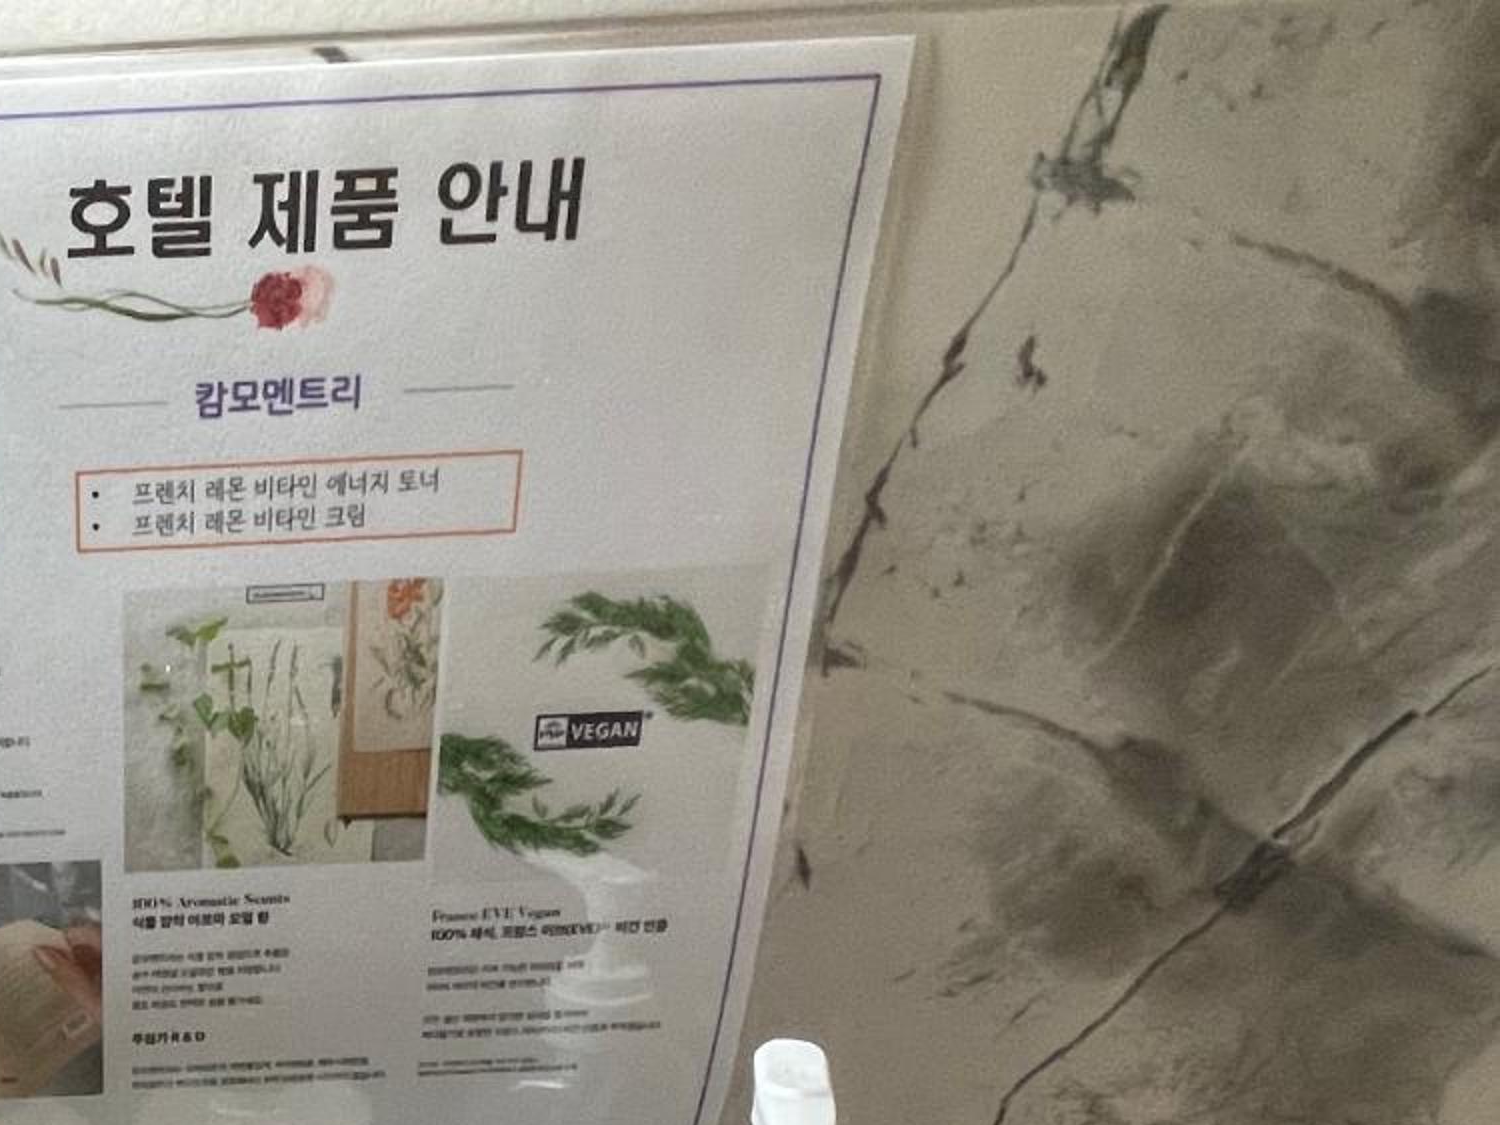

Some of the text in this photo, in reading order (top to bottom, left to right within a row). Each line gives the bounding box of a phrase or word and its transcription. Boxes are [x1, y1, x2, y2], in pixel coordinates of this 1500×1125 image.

[67, 157, 586, 259] 호텔 제품 안내
[194, 374, 361, 419] 캄모멘트리
[132, 478, 195, 505] 프렌치
[205, 475, 247, 502] 레몬
[325, 469, 390, 496] 에너지
[397, 467, 442, 493] 토너
[132, 510, 195, 537] 프렌치
[205, 508, 247, 534] 레몬
[571, 720, 640, 741] VEGAN
